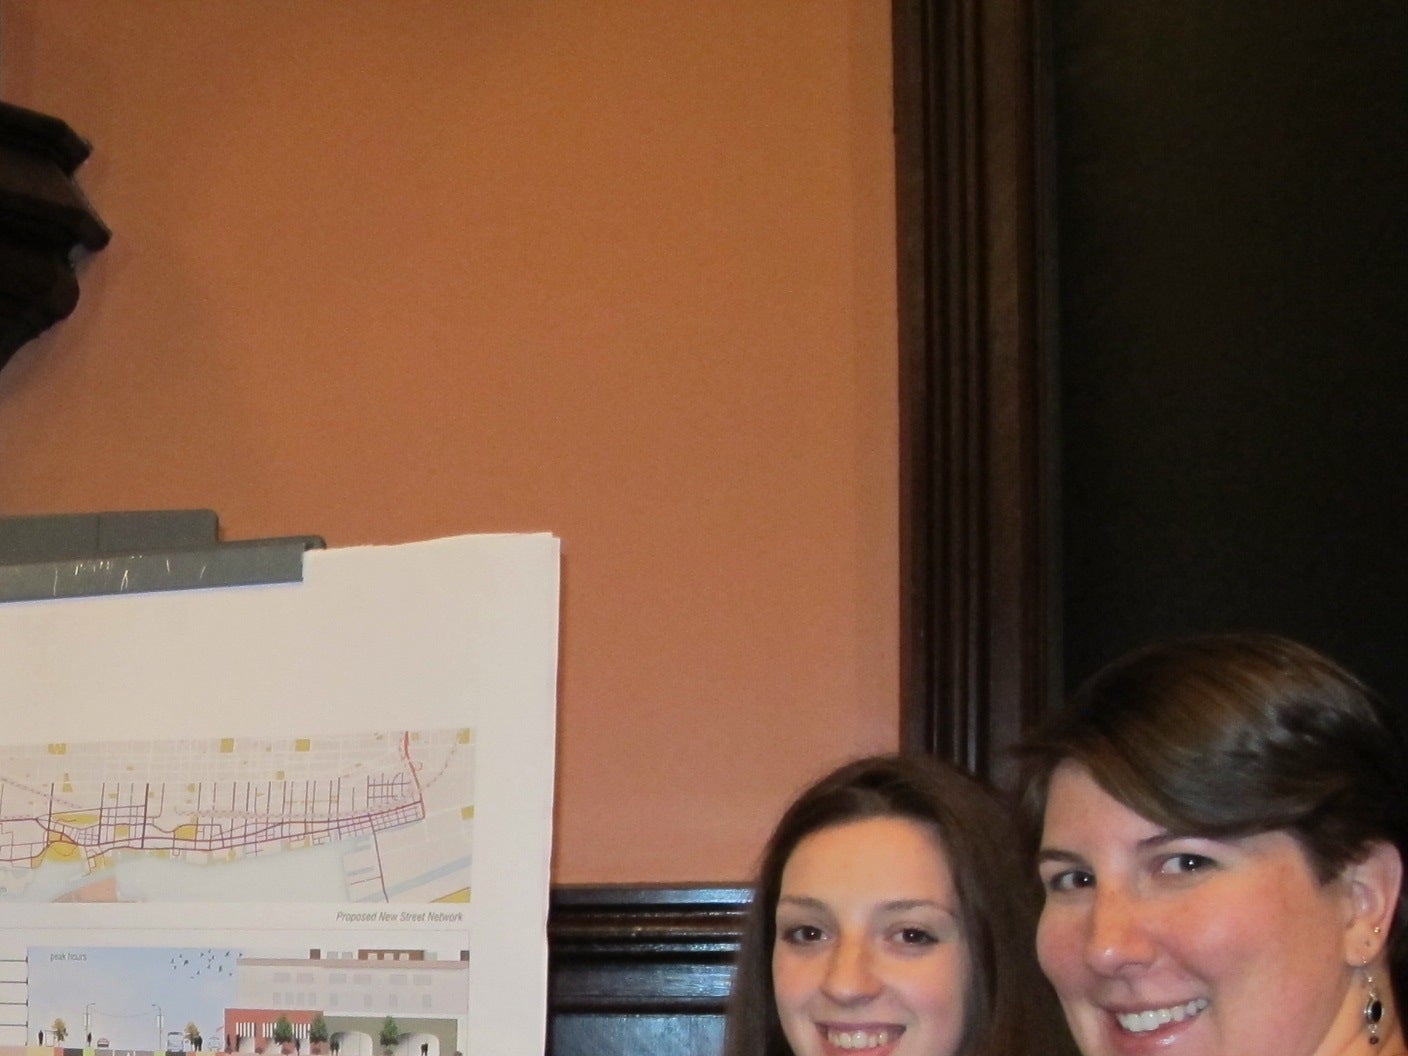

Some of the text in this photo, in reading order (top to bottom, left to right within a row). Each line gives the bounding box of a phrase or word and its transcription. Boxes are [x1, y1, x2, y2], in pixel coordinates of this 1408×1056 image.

[336, 912, 462, 922] Proposed New Street Network
